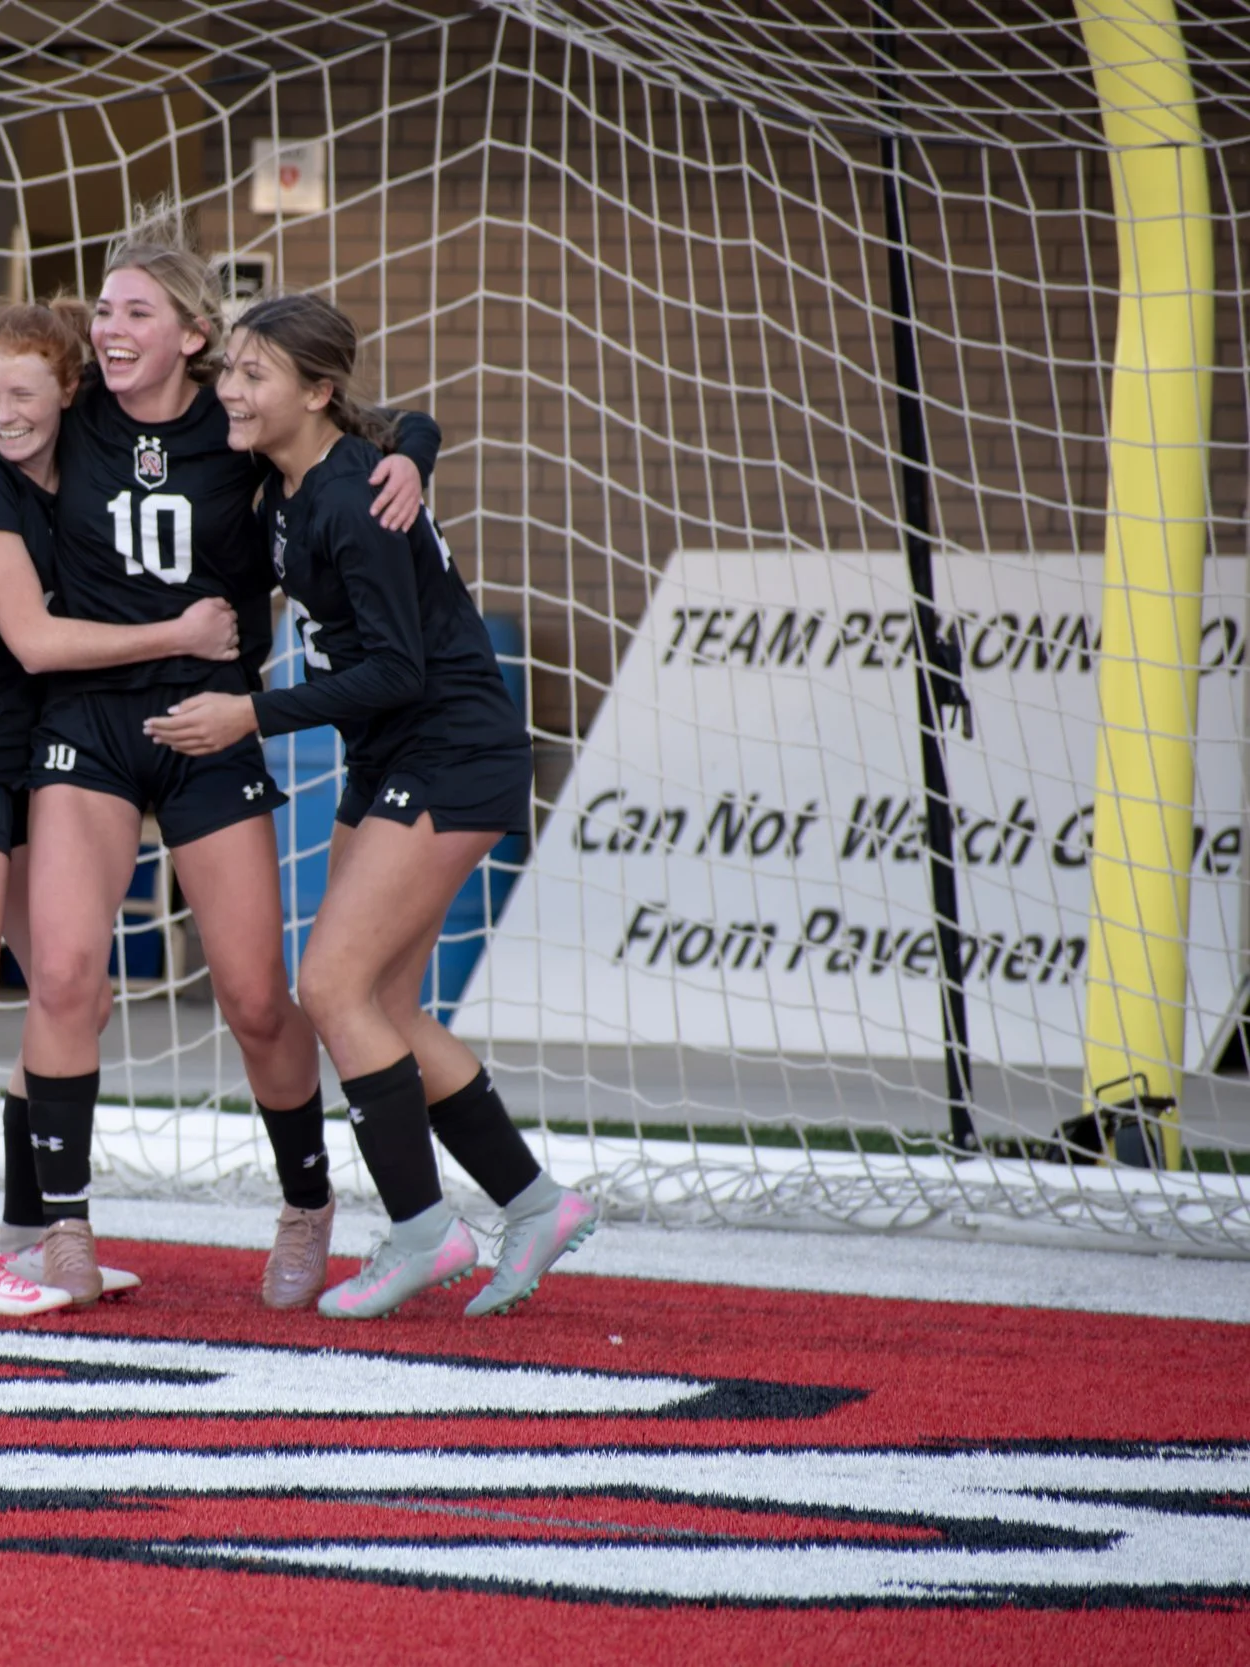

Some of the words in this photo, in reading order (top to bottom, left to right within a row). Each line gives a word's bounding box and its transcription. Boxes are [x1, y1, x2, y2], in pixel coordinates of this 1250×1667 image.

[107, 490, 192, 584] 10
[661, 607, 825, 669] TEAM
[44, 744, 77, 771] 10
[572, 789, 687, 856] Can
[695, 791, 818, 859] Not
[615, 900, 778, 971] From
[784, 906, 1090, 985] Pavemen
